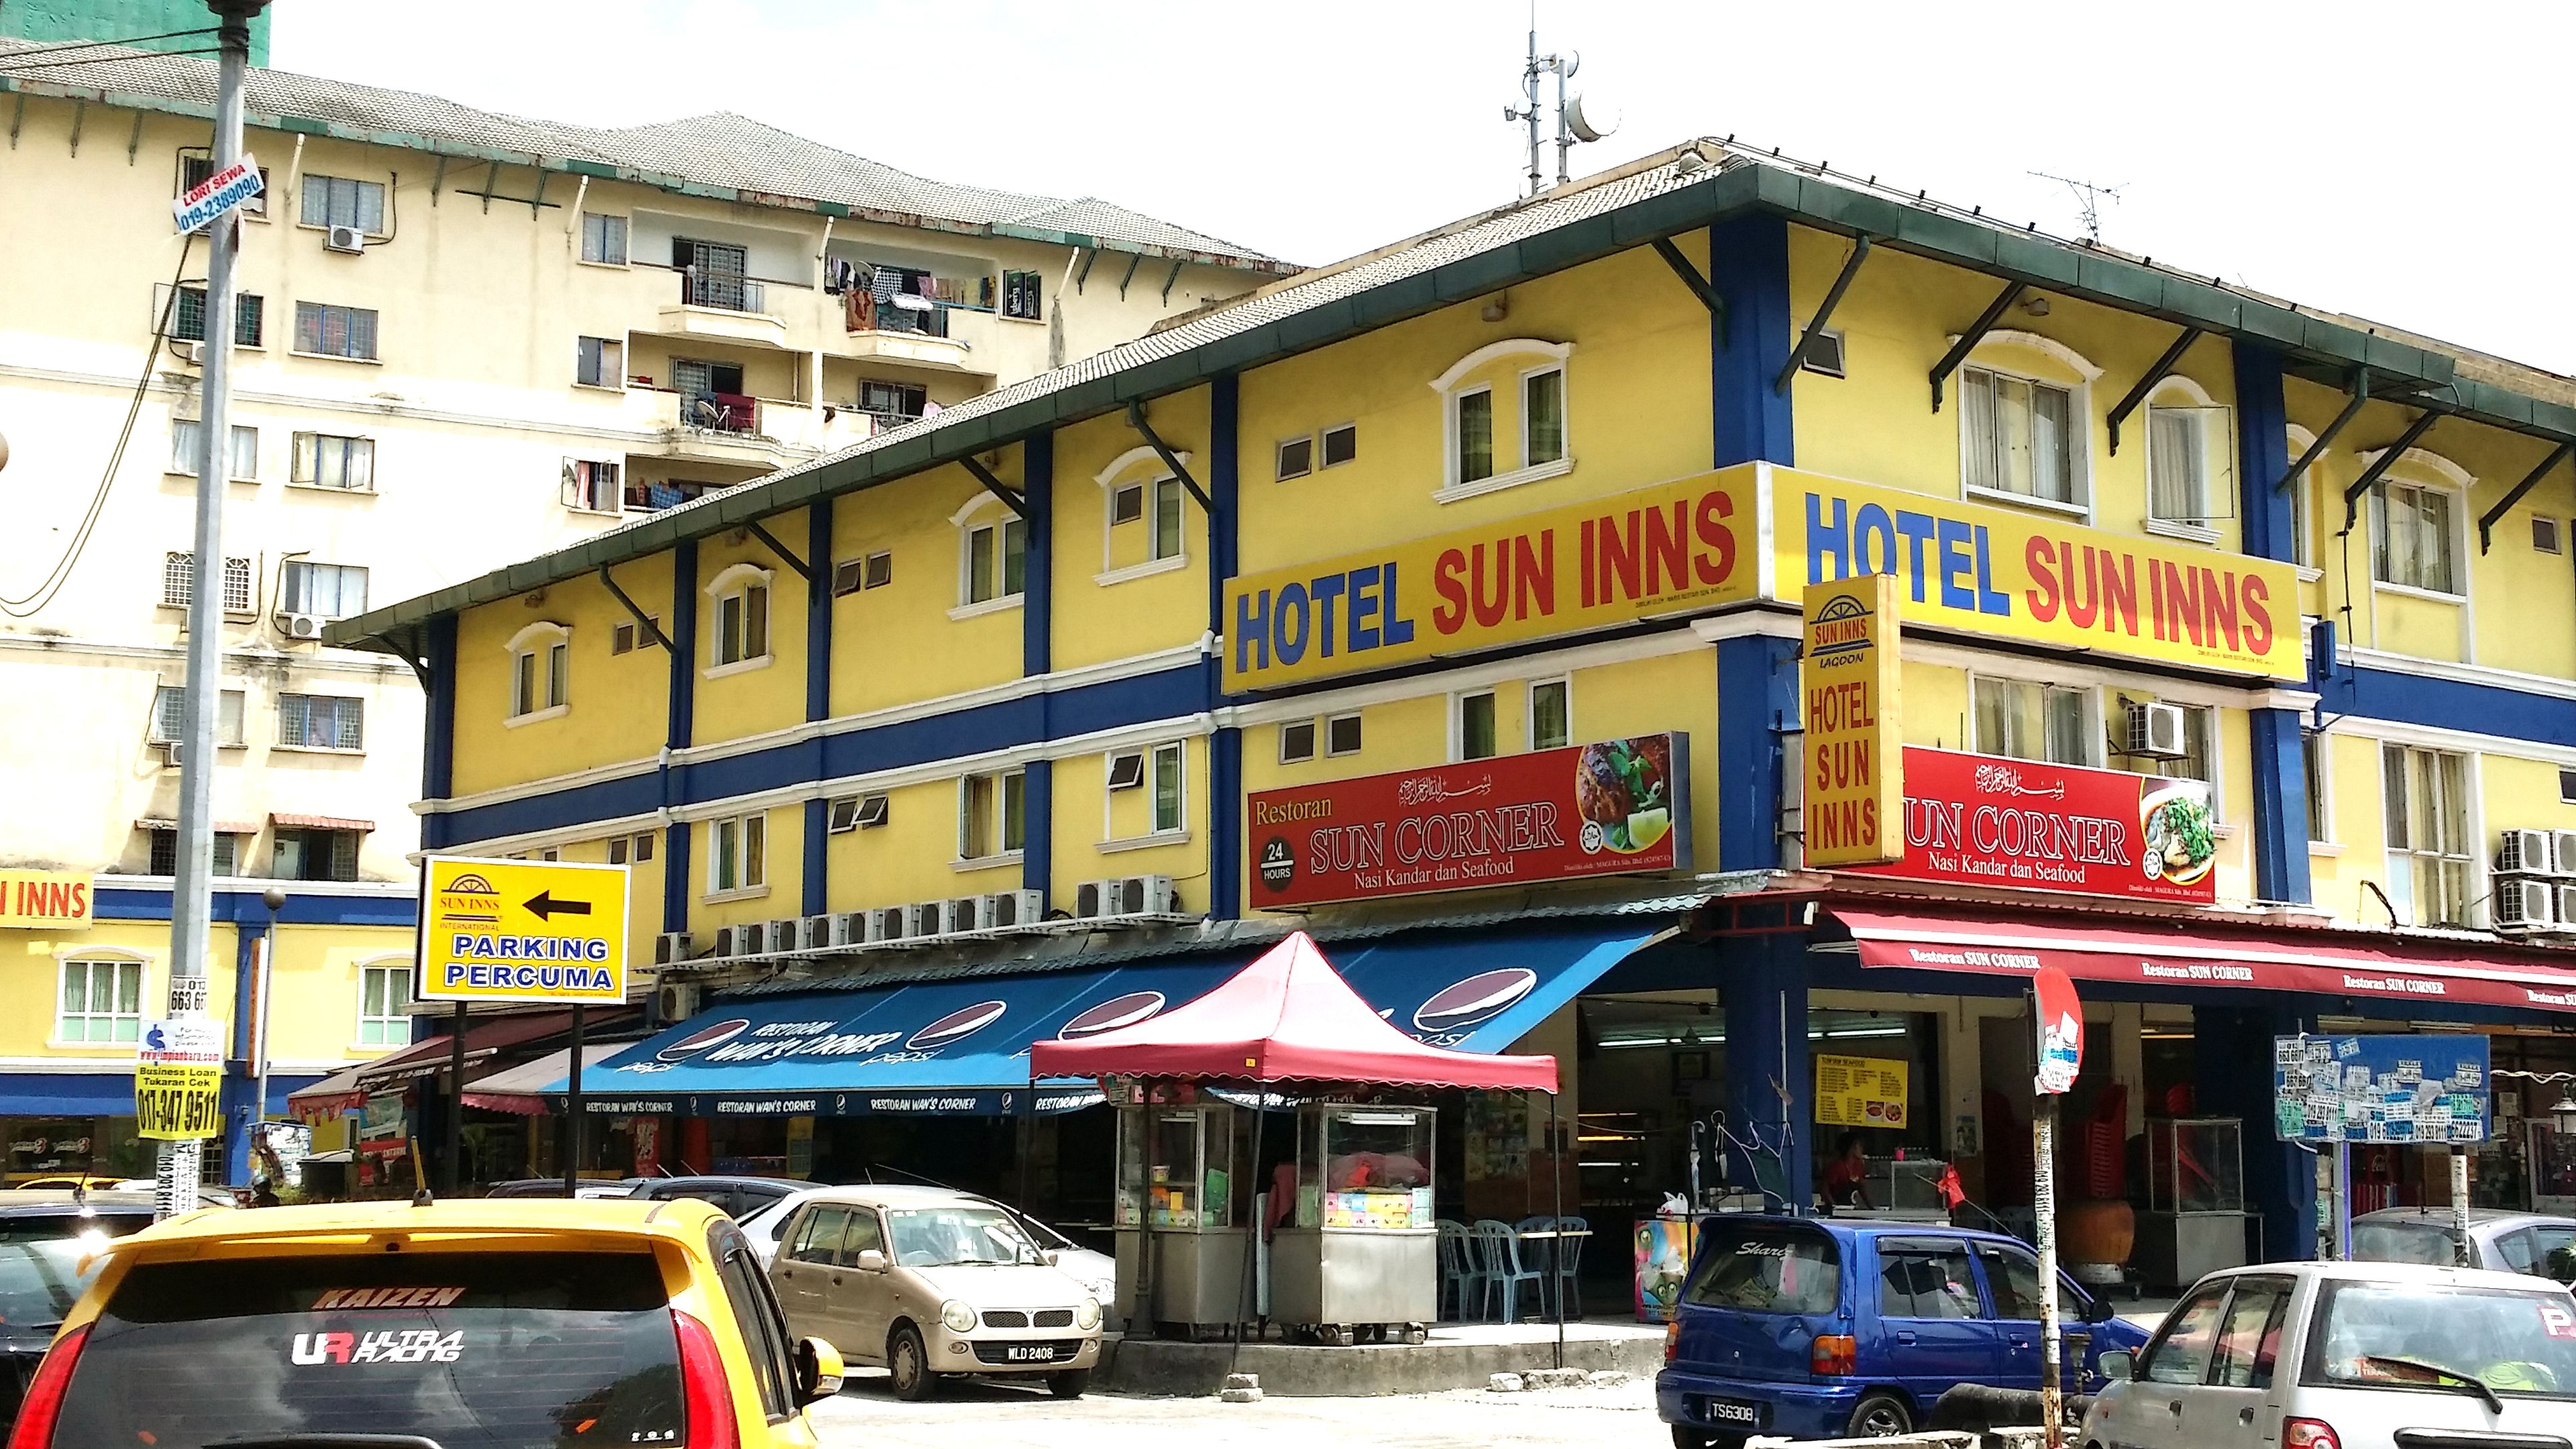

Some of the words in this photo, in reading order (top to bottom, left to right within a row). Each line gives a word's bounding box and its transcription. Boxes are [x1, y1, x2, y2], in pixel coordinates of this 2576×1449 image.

[183, 184, 211, 207] LORI
[213, 164, 246, 189] SEWA
[180, 174, 260, 230] 019-2389090
[1236, 562, 1414, 674] HOTEL
[1432, 529, 1555, 636] SUN
[1580, 490, 1736, 608] INNS
[1805, 492, 2010, 617] HOTEL
[2025, 535, 2139, 637] SUN
[2148, 557, 2273, 655] INNS
[1815, 623, 1837, 645] SUN
[1840, 618, 1866, 641] INNS
[1820, 653, 1864, 669] LAGOON
[1811, 682, 1874, 734] HOTEL
[1817, 740, 1870, 792] SUN
[1256, 798, 1332, 825] Restoran
[1813, 797, 1876, 850] INNS
[1903, 797, 1964, 849] UN
[1972, 806, 2131, 866] CORNER
[1309, 822, 1386, 875] SUN
[1395, 802, 1565, 861] CORNER
[1268, 843, 1284, 861] 24
[1264, 867, 1292, 880] HOURS
[1354, 871, 1383, 890] Nasi
[1385, 867, 1432, 887] Kandar
[1434, 864, 1458, 882] dan
[1461, 857, 1515, 879] Seafood
[1928, 851, 1957, 871] Nasi
[1962, 855, 2006, 877] Kandar
[2010, 859, 2033, 879] dan
[2035, 861, 2086, 883] Seafood
[17, 881, 85, 918] INNS
[440, 898, 465, 908] SUN
[470, 898, 500, 910] INNS
[440, 922, 499, 931] INTERNATIONAL
[453, 934, 608, 961] PARKING
[1909, 948, 1966, 965] Restoran
[1964, 951, 1991, 967] SUN
[1992, 953, 2041, 969] CORNER
[445, 963, 613, 989] PERCUMA
[2141, 962, 2189, 978] Restoran
[2189, 965, 2212, 979] SUN
[2212, 965, 2254, 981] CORNER
[2343, 974, 2385, 990] Restoran
[2385, 977, 2406, 991] SUN
[2407, 979, 2446, 995] CORNER
[171, 991, 191, 1010] 663
[2527, 989, 2565, 1005] Restoran
[2565, 992, 2576, 1006] SU
[750, 1020, 838, 1036] RESTORAN
[1410, 1030, 1477, 1046] psi
[705, 1037, 796, 1061] WAN'S
[784, 1032, 902, 1057] CORNER
[859, 1049, 945, 1067] pepsi
[140, 1067, 186, 1076] Business
[189, 1069, 217, 1077] Loan
[144, 1077, 185, 1086] Tukaran
[189, 1079, 211, 1087] Cek
[138, 1089, 182, 1132] 017-347
[184, 1090, 217, 1132] 9511
[586, 1102, 619, 1113] RESTORAN
[621, 1101, 644, 1112] WAN'S
[645, 1102, 673, 1112] CORNER
[717, 1101, 755, 1112] RESTORAN
[756, 1099, 782, 1112] WAN'S
[783, 1100, 816, 1112] CORNER
[871, 1098, 911, 1111] RESTORAN
[912, 1097, 938, 1110] WAN'S
[938, 1097, 976, 1110] CORNER
[1034, 1096, 1083, 1110] RESTORAN
[311, 1287, 466, 1309] KAIZEN
[2540, 1307, 2572, 1336] P
[291, 1332, 354, 1366] UR
[360, 1330, 464, 1348] ULTRA
[351, 1345, 464, 1364] RACING
[1008, 1347, 1027, 1360] WLD
[1028, 1347, 1053, 1360] 2408
[1712, 1403, 1754, 1421] TS6308
